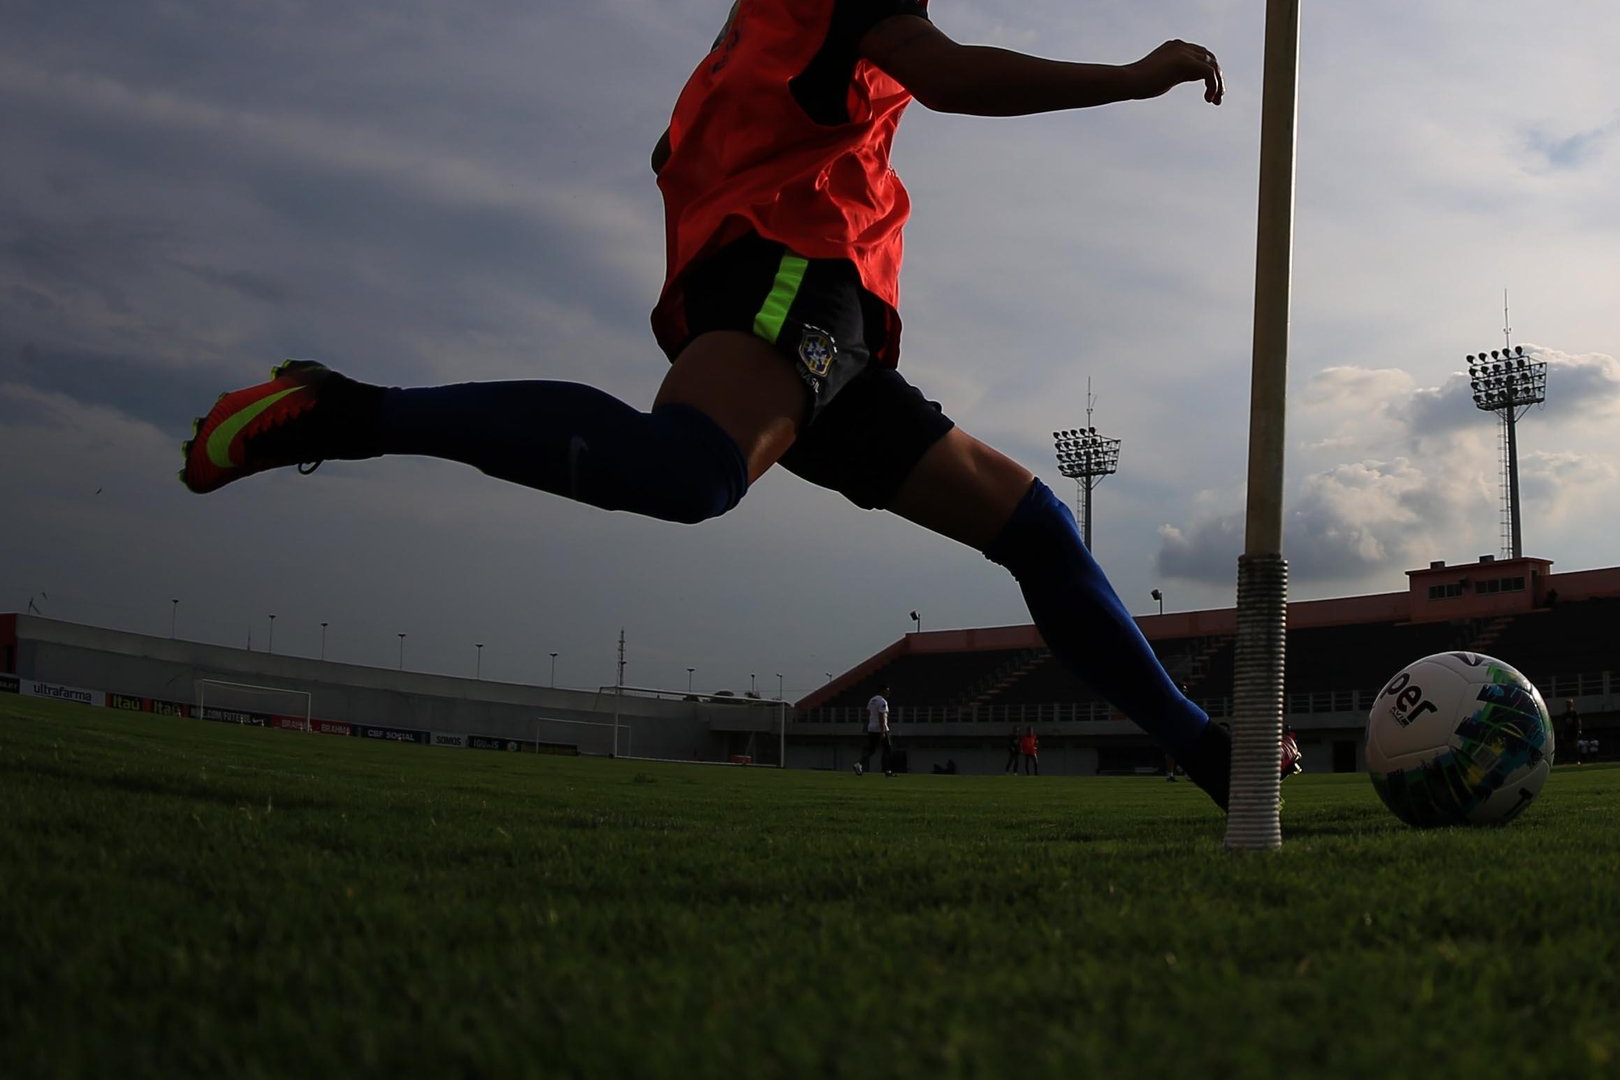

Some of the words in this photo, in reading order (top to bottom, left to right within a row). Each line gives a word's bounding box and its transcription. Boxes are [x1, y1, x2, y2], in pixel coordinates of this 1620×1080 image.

[33, 683, 92, 701] ultrafarma
[112, 695, 140, 710] Itaú
[436, 735, 461, 746] SOMOS
